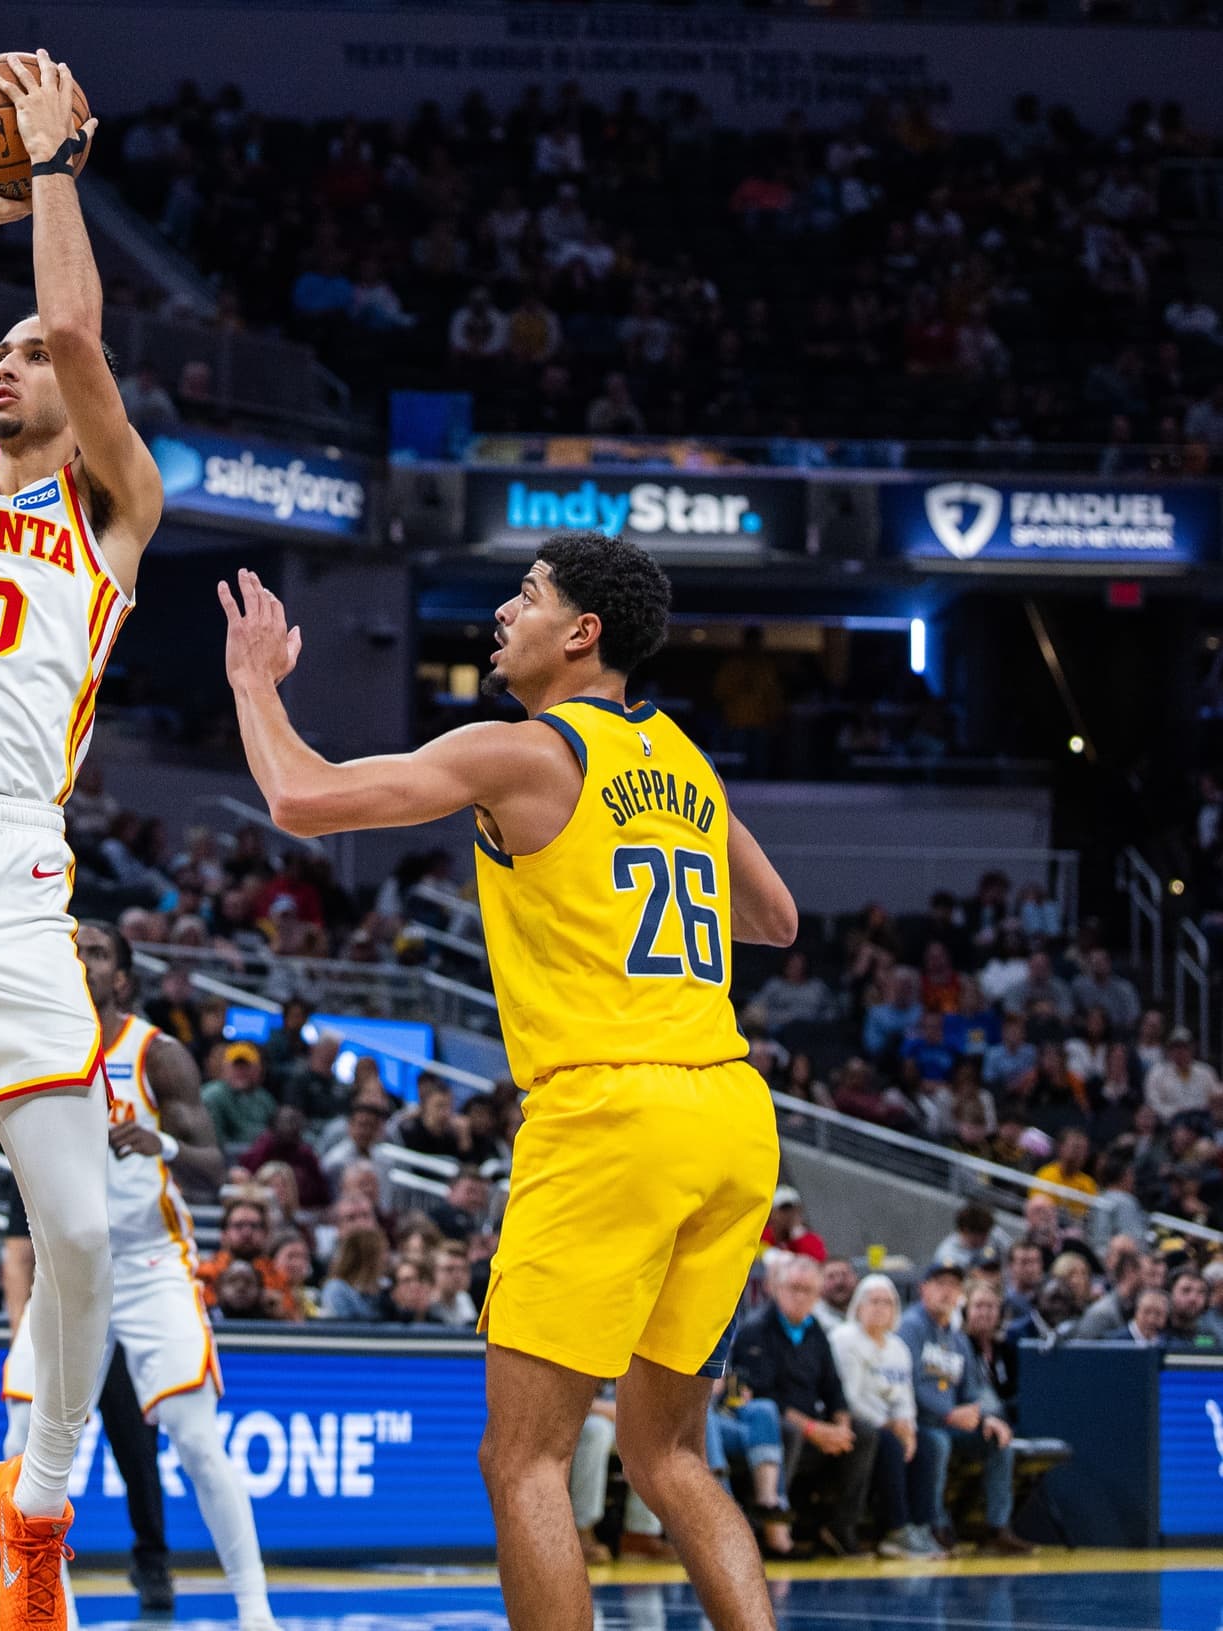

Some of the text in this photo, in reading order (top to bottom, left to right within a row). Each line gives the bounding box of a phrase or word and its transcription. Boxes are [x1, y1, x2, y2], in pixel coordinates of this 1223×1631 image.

[16, 487, 57, 508] paze
[205, 451, 364, 519] salesforce
[1010, 492, 1176, 528] FANDUEL
[601, 768, 716, 834] SHEPPARD
[612, 845, 724, 986] 26
